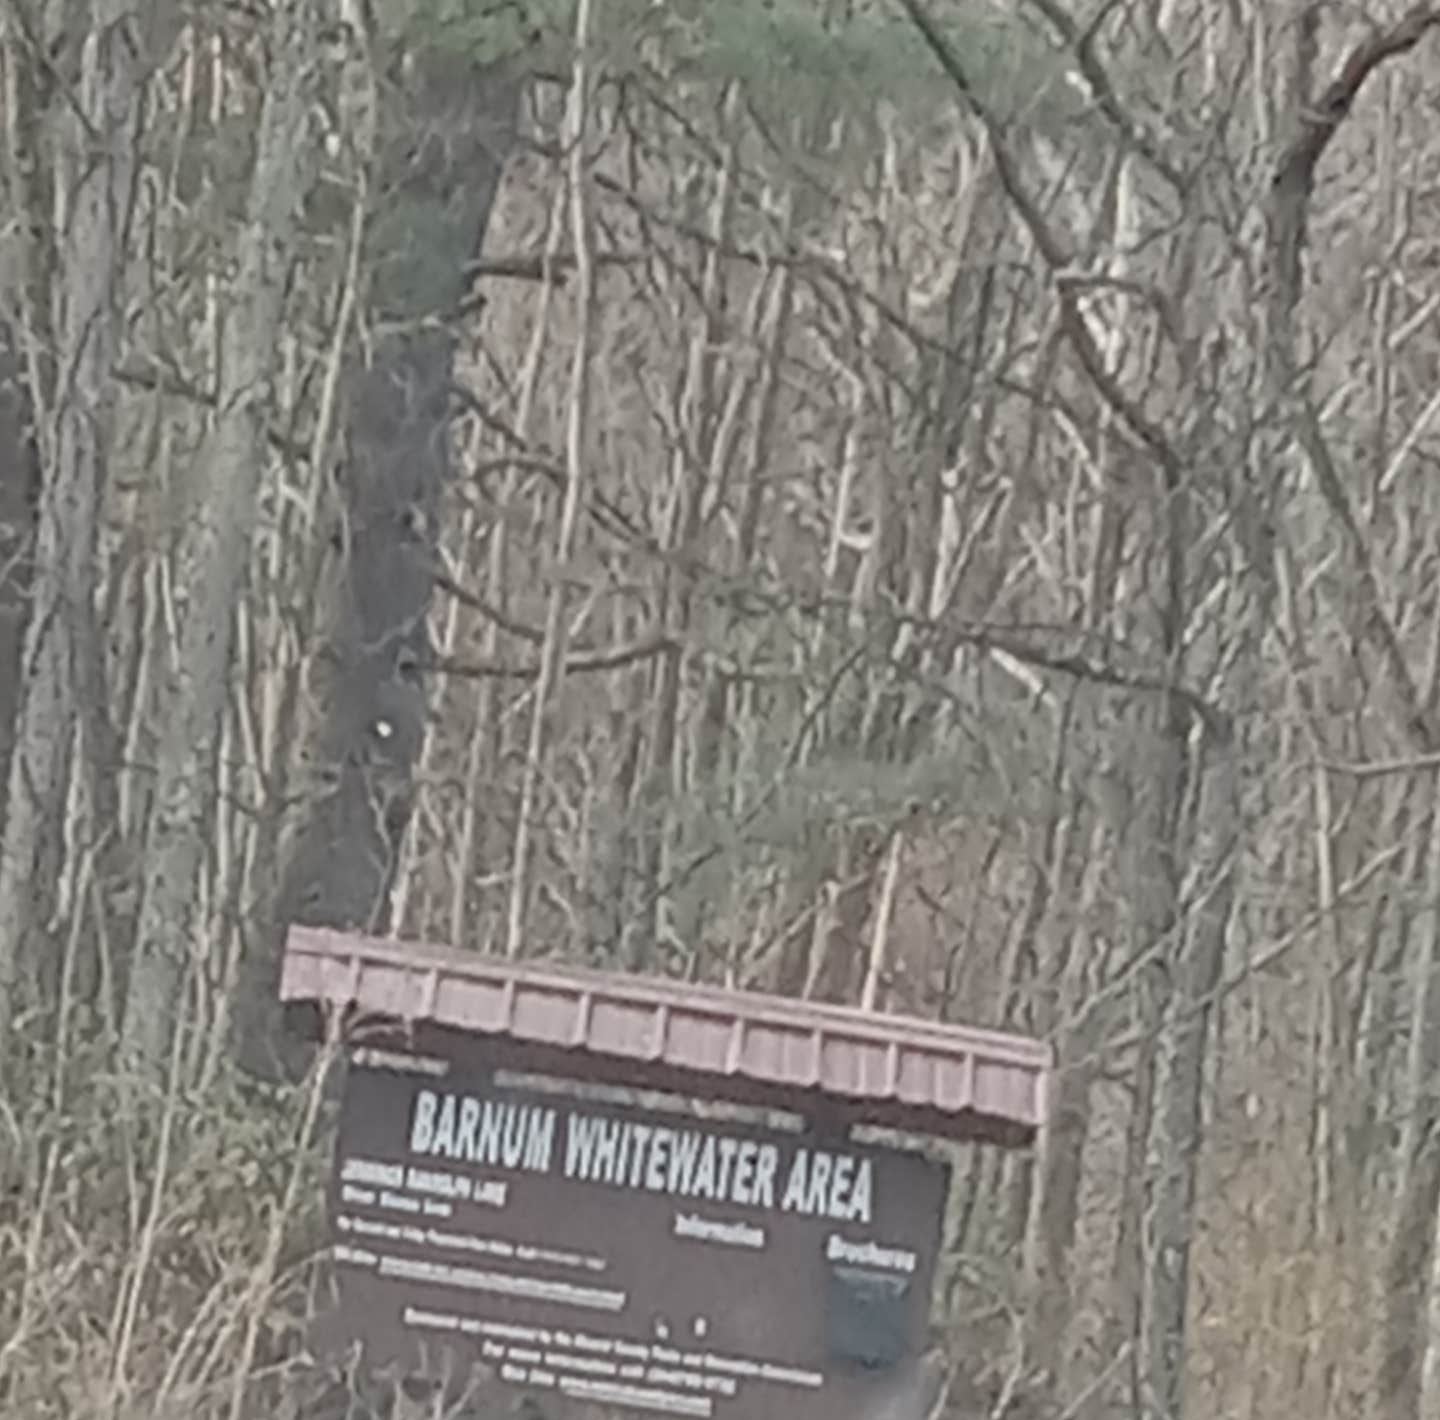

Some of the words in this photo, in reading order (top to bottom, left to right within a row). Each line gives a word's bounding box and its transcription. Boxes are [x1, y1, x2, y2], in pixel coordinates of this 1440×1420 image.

[411, 1089, 556, 1174] BARNUM
[564, 1111, 779, 1209] WHITEWATER
[781, 1148, 872, 1223] AREA
